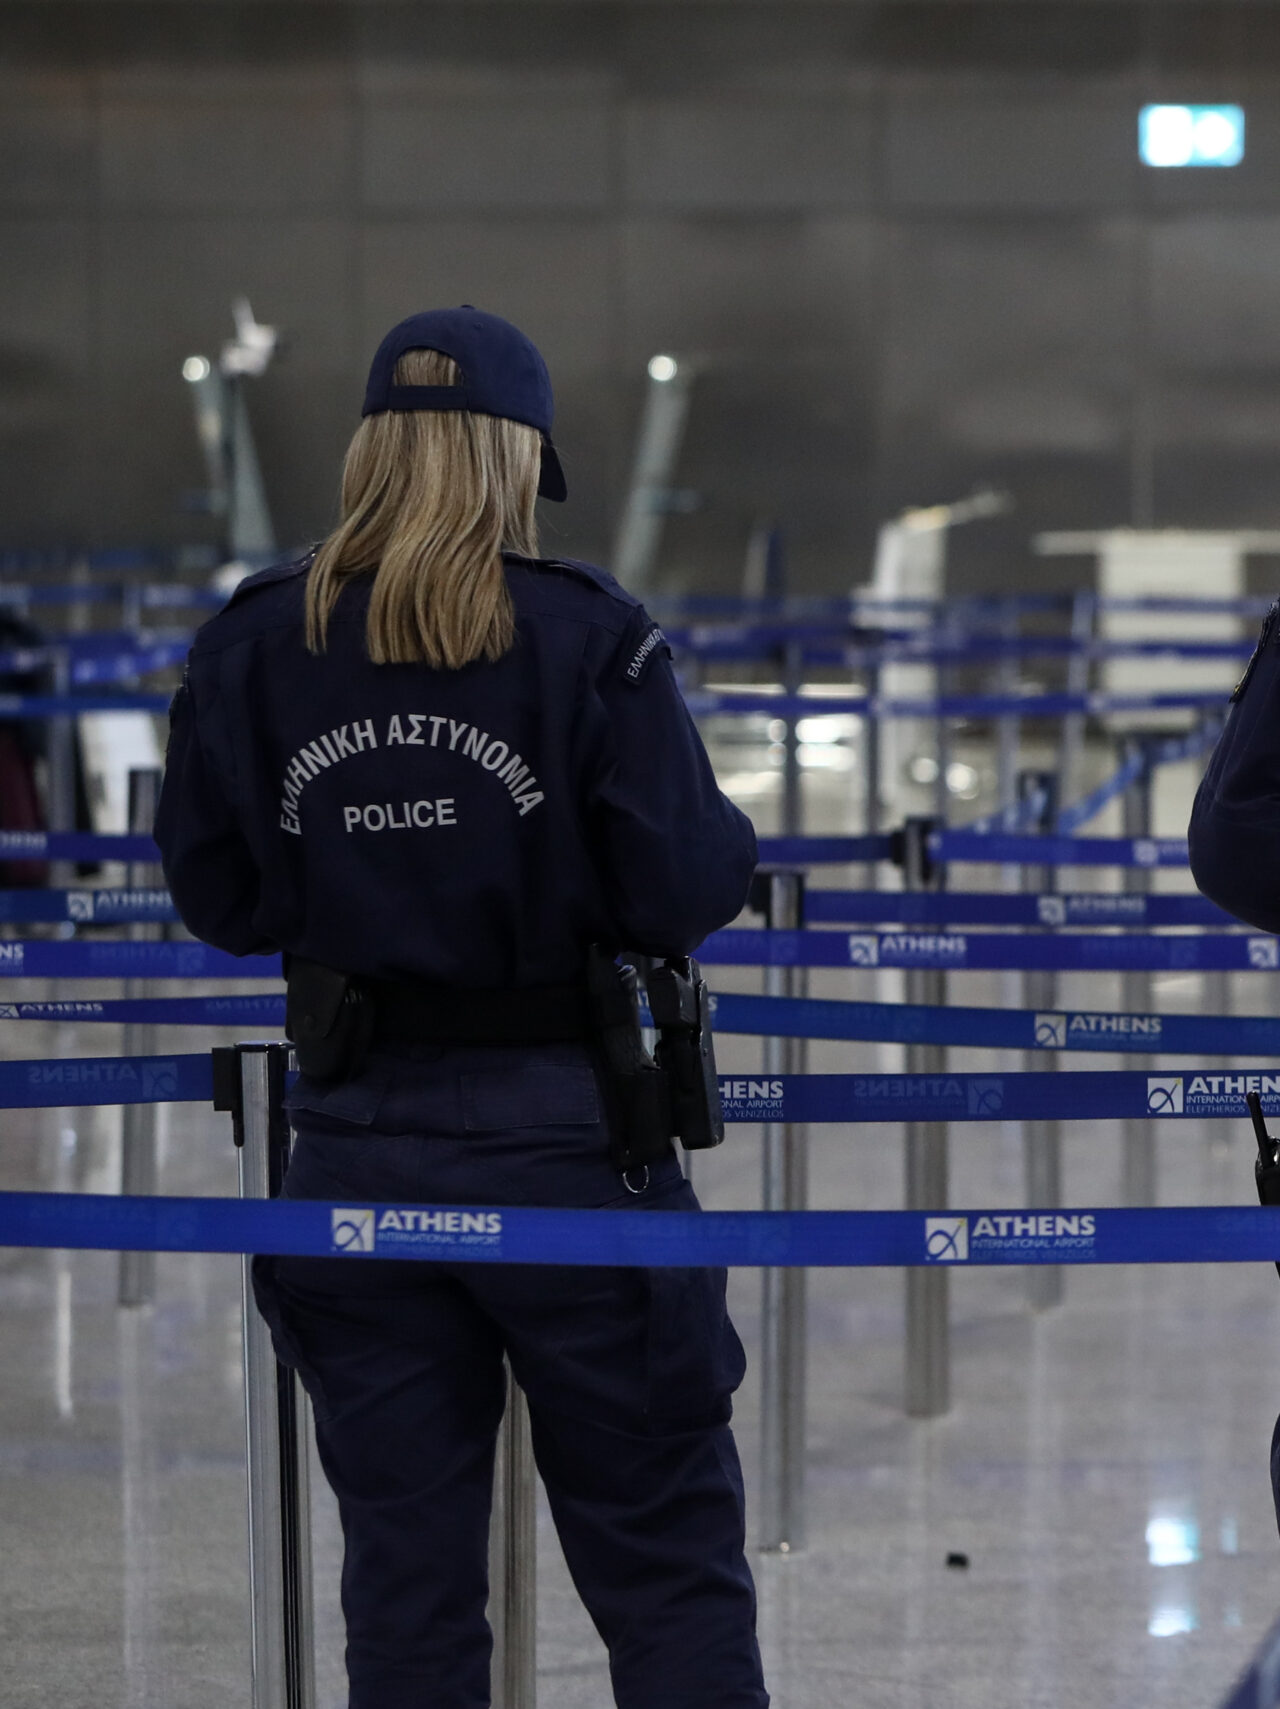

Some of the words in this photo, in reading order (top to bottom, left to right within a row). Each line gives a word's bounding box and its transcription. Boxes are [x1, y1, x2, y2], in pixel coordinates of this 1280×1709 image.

[280, 719, 378, 835] ΕΛΛΗΝΙΚΗ
[386, 713, 545, 817] ΑΣΤΥΝΟΜΙΑ
[343, 798, 457, 833] POLICE
[881, 935, 967, 952] ATHENS
[20, 1002, 104, 1012] ATHENS
[1069, 1015, 1162, 1033] ATHENS
[718, 1081, 784, 1099] HENS
[747, 1100, 784, 1108] AIRPORT
[1186, 1095, 1247, 1104] INTERNATION
[1186, 1105, 1246, 1113] ELEFTHERIOS
[378, 1210, 503, 1233] ATHENS
[972, 1215, 1097, 1237] ATHENS
[972, 1239, 1051, 1249] INTERNATIONAL
[1053, 1237, 1097, 1248] AIRPORT
